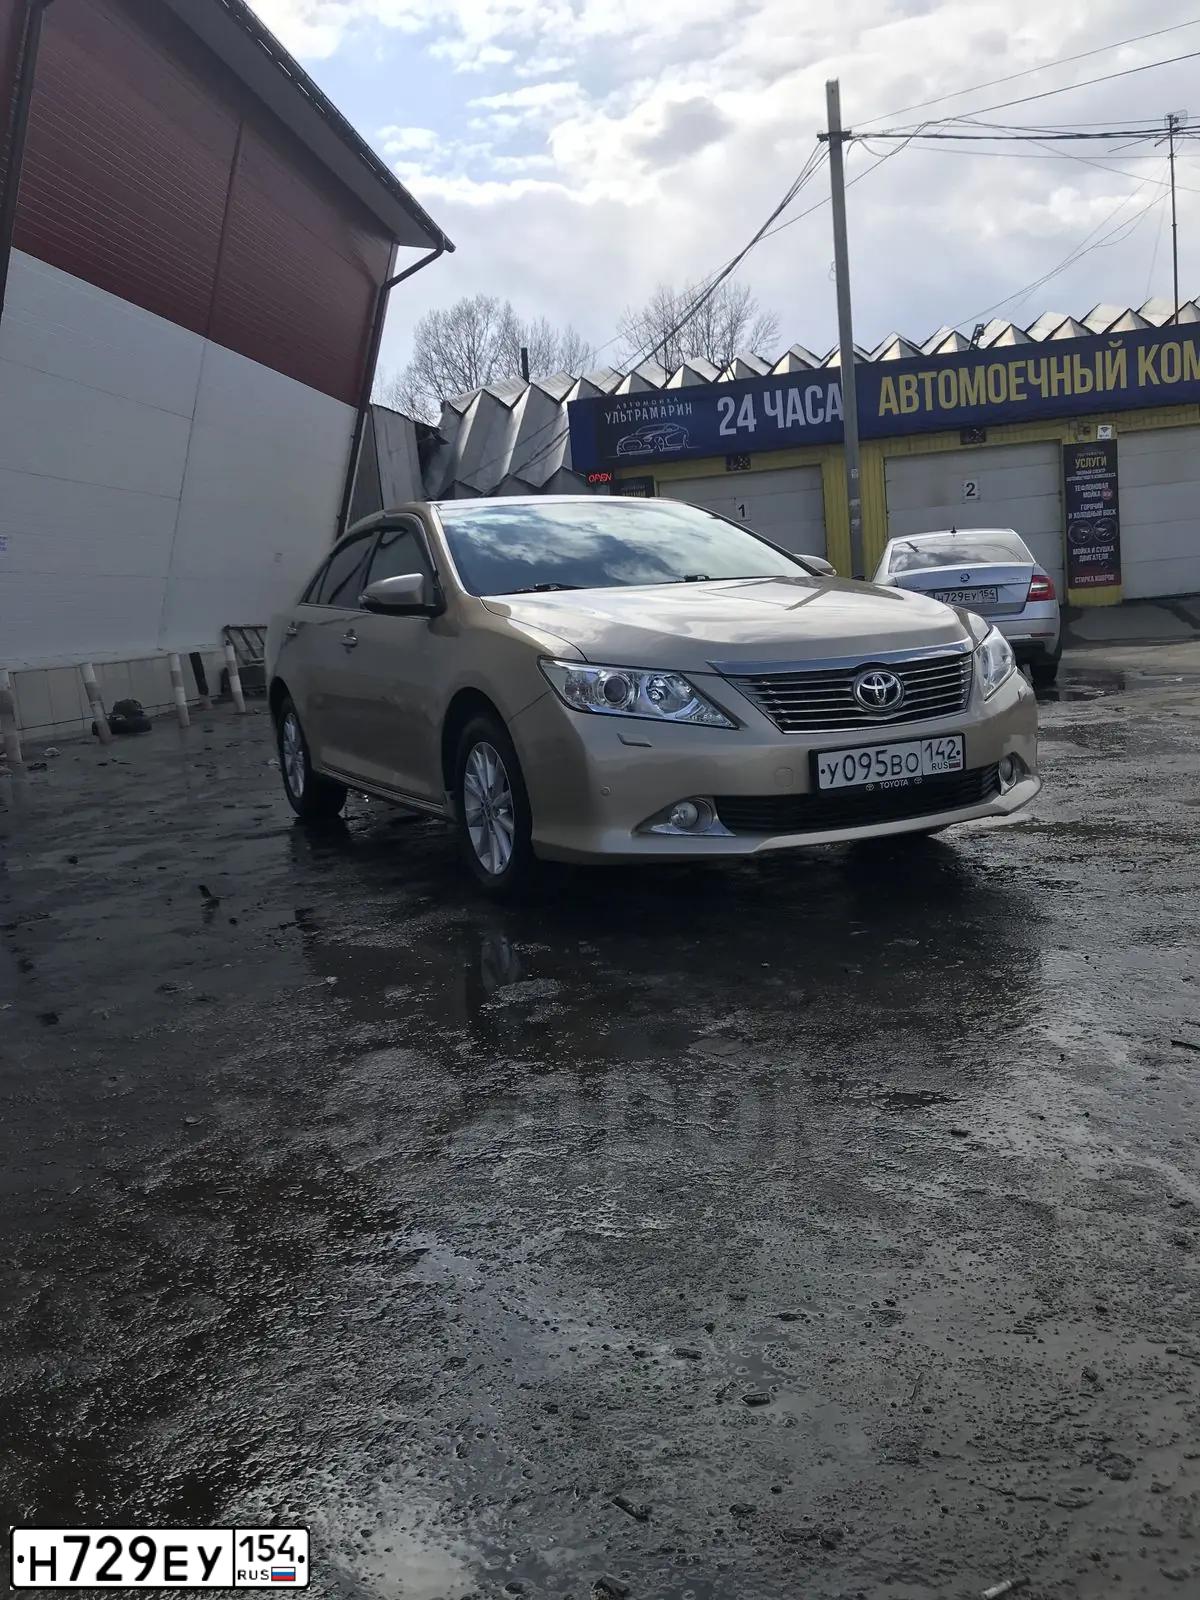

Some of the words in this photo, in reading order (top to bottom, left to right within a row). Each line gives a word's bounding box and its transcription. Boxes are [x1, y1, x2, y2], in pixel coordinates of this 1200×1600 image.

[878, 339, 1128, 416] АВТОМОЕЧНЫЙ
[1138, 339, 1200, 387] КОМ
[605, 402, 692, 424] УЛЬТРАМАРИН
[717, 393, 757, 436] 24
[764, 383, 845, 428] ЧАСА
[1075, 456, 1107, 469] УСЛУГИ
[588, 472, 612, 483] OPEN
[965, 482, 977, 497] 2
[738, 504, 746, 518] 1
[979, 589, 995, 597] 154
[827, 750, 919, 785] У095ВО
[924, 739, 957, 762] 142
[931, 761, 949, 771] RUS
[880, 779, 909, 790] TOYOTA
